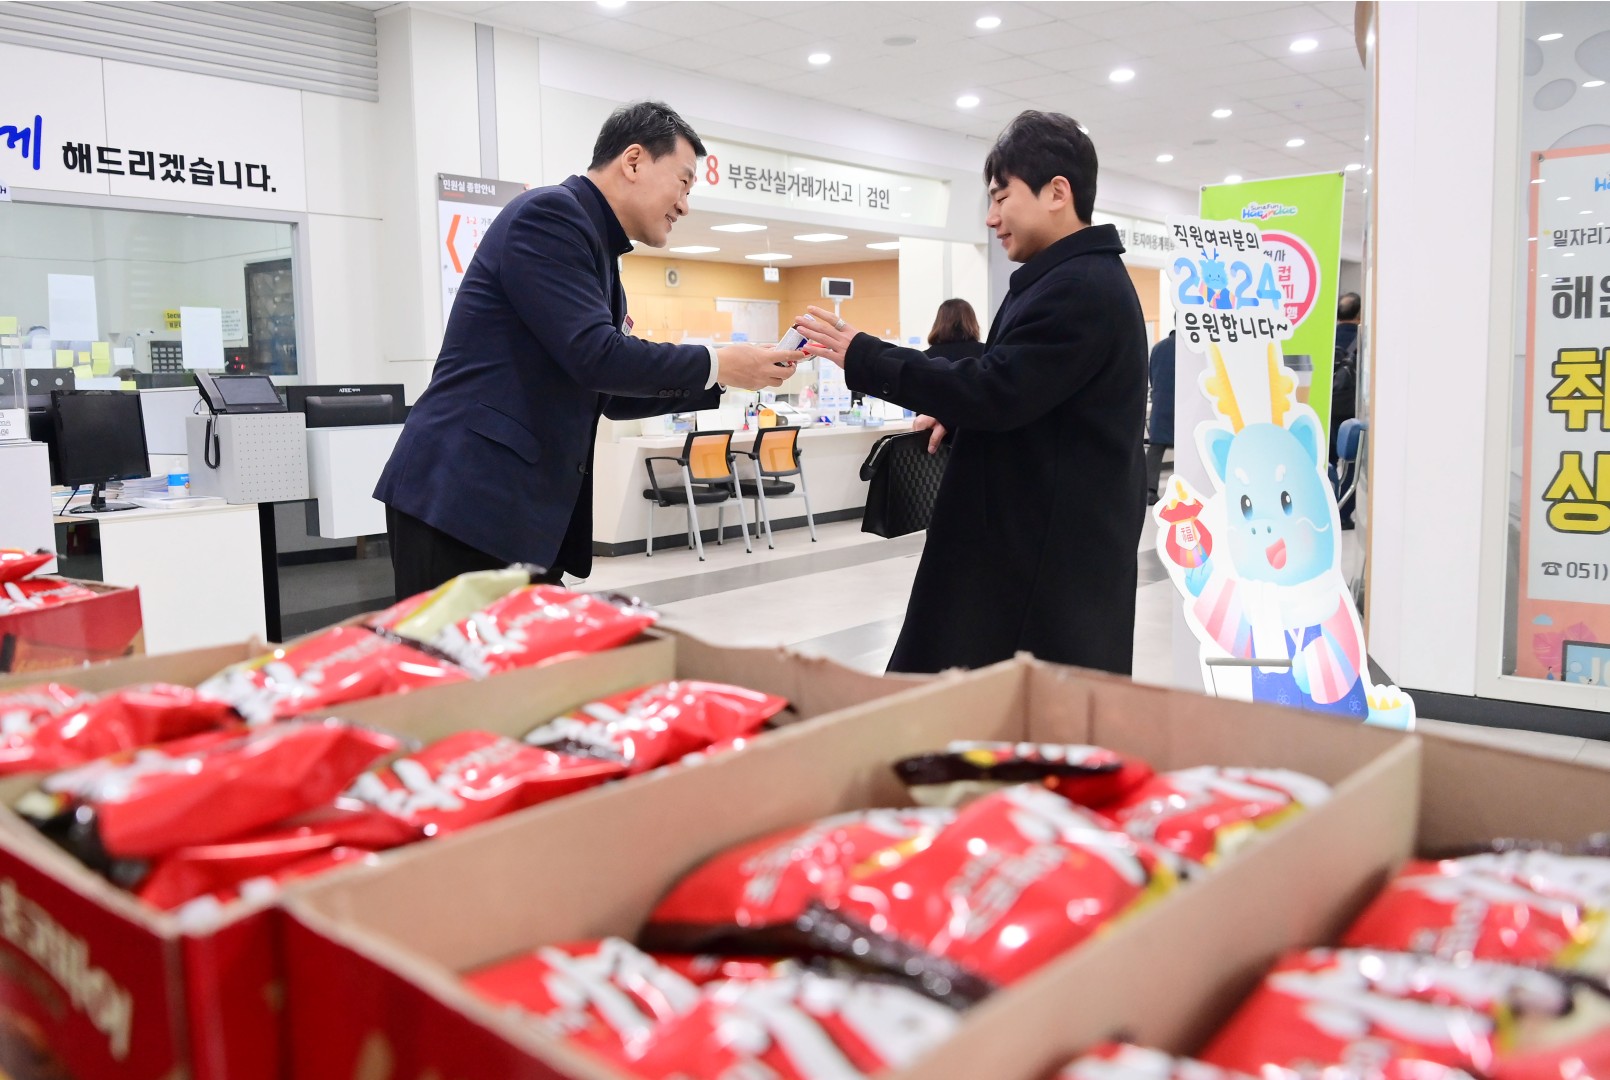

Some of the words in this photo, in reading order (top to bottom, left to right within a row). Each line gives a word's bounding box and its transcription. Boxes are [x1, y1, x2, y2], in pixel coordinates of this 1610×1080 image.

[62, 142, 276, 192] 해드리겠습니다.
[443, 179, 465, 192] 민원실
[467, 182, 496, 196] 종합안내
[706, 155, 719, 185] 8
[728, 163, 852, 203] 부동산실거래가신고
[867, 187, 890, 209] 검인
[1173, 224, 1260, 252] 직원여러분의
[1184, 312, 1288, 343] 응원합니다~
[1566, 561, 1609, 581] 051)
